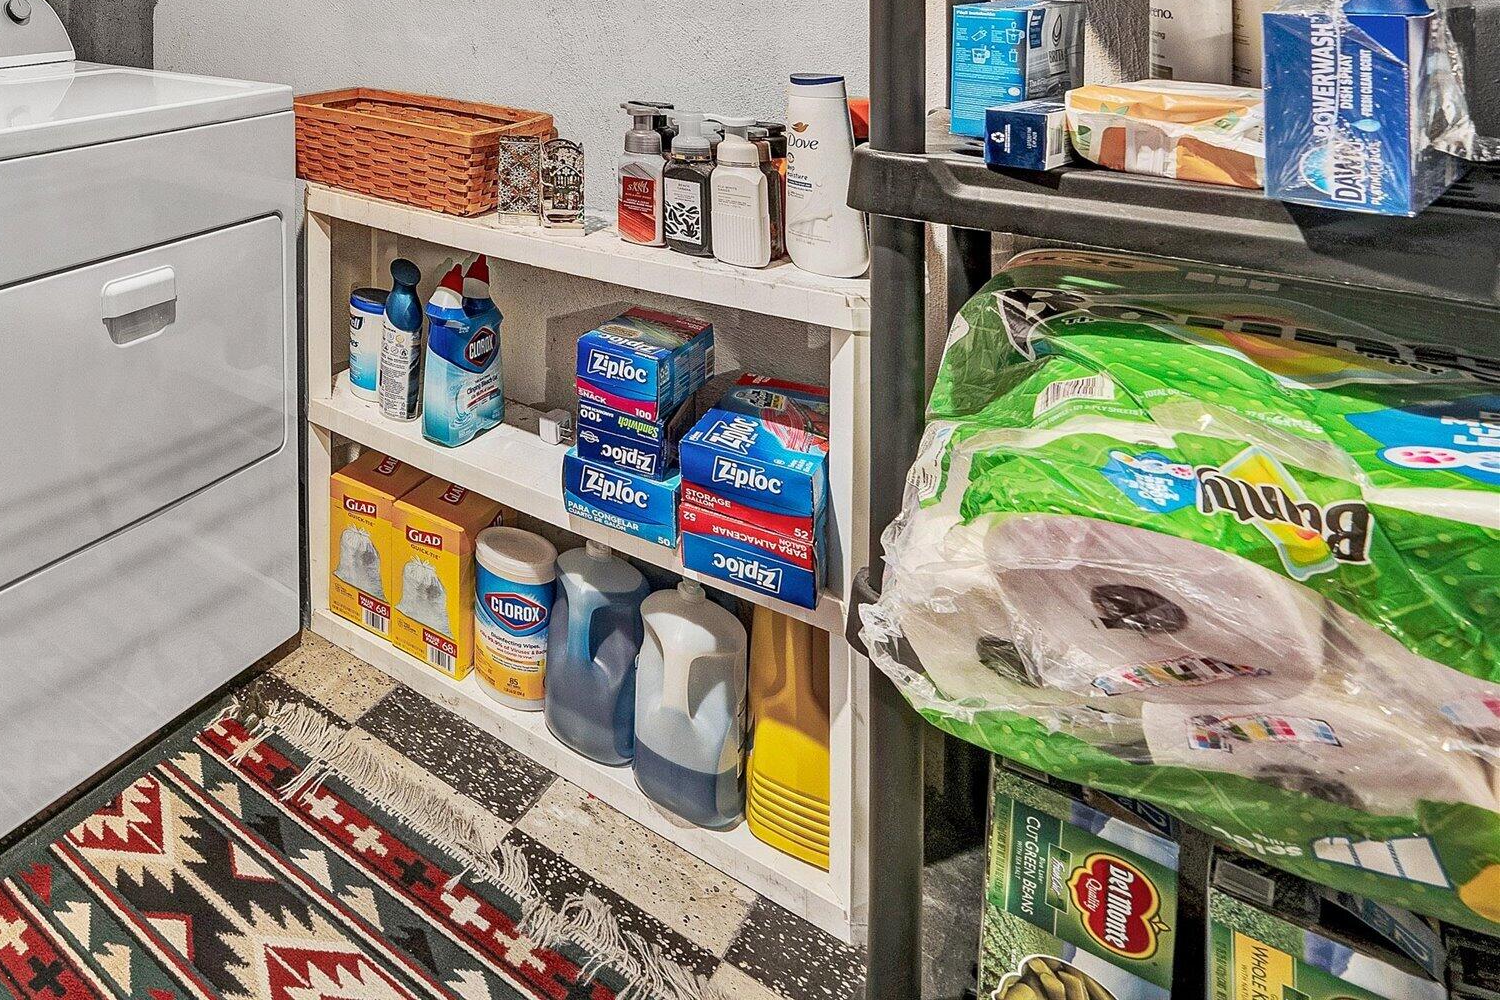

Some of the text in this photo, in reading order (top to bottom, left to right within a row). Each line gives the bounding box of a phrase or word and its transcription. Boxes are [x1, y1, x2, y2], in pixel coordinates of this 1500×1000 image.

[1359, 50, 1372, 72] SCENT
[1311, 21, 1337, 137] POWERWASH
[1340, 54, 1354, 110] DISH SPRAY
[1360, 73, 1373, 95] CLEAN
[788, 133, 819, 150] Dove
[469, 332, 494, 359] CLOROX
[593, 352, 647, 383] Ziploc
[577, 387, 607, 404] SNACK
[580, 411, 602, 423] 100
[592, 407, 614, 417] SANDWICH
[634, 407, 653, 420] 100
[618, 416, 659, 438] Sandwich
[709, 416, 758, 449] Ziploc
[602, 444, 651, 471] Ziploc
[718, 460, 783, 494] Ziploc
[586, 469, 648, 508] Ziploc
[685, 488, 731, 508] STORAGE
[345, 499, 376, 514] GLAD
[685, 495, 715, 508] GALLON
[567, 501, 639, 531] PARA CONGELAR
[568, 508, 593, 520] CUARTO
[683, 511, 696, 522] 52
[1197, 466, 1372, 562] Bounty
[408, 530, 441, 547] GLAD
[657, 536, 671, 547] 50
[712, 525, 807, 560] PARA ALMACENAR
[794, 528, 809, 540] 52
[713, 553, 776, 589] Ziploc
[359, 594, 374, 606] VALUE
[360, 600, 387, 615] PACK 68
[491, 596, 540, 622] CLOROX
[424, 630, 440, 643] VALUE
[425, 637, 454, 654] PACK 68
[488, 636, 503, 647] 99.9%
[491, 632, 522, 649] Disinfecting
[509, 677, 519, 686] 85
[1014, 866, 1022, 880] SALT
[1020, 816, 1041, 915] CUT GREEN BEANS
[1085, 878, 1103, 912] Quality
[1104, 863, 1134, 949] Del Monte
[1251, 945, 1268, 991] WHOLE
